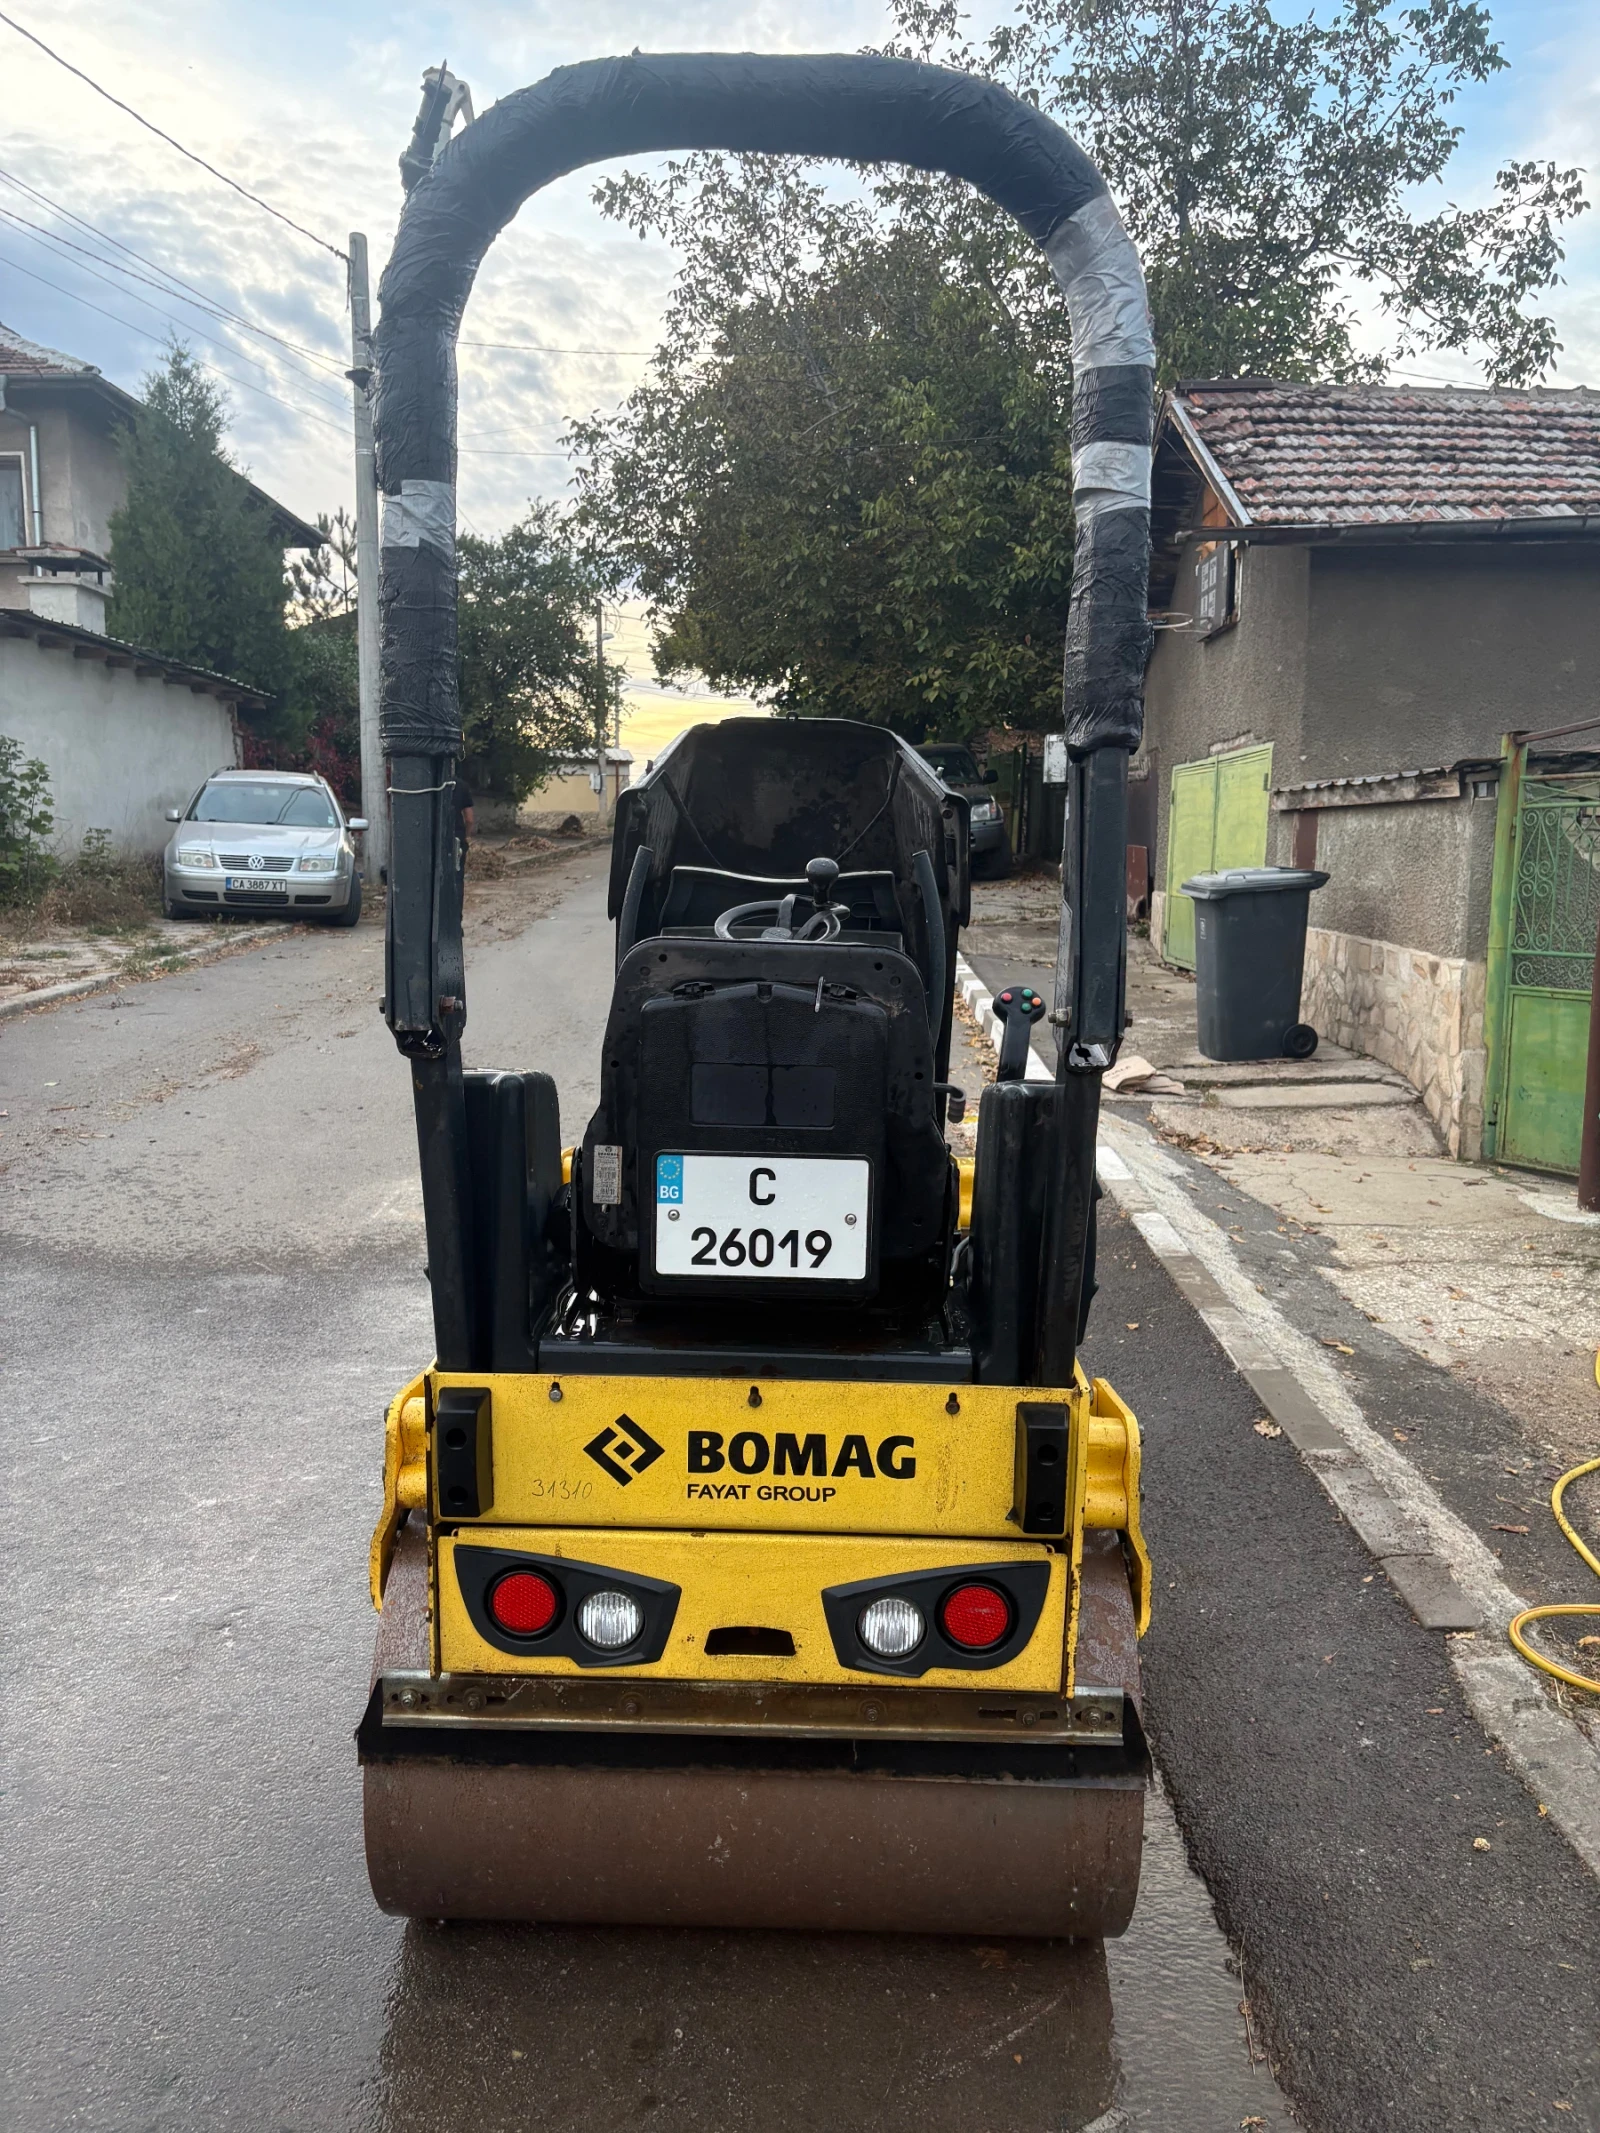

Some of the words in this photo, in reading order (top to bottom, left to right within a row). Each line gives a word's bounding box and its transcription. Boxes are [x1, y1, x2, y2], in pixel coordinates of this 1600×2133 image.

[232, 879, 245, 889] CA
[246, 880, 270, 890] 3887
[272, 881, 284, 892] XT
[659, 1185, 680, 1199] BG
[749, 1167, 776, 1206] C
[690, 1226, 832, 1269] 26019
[687, 1430, 917, 1480] BOMAG
[531, 1479, 593, 1500] 31310
[687, 1484, 751, 1499] FAYAT
[756, 1485, 836, 1503] GROUP
